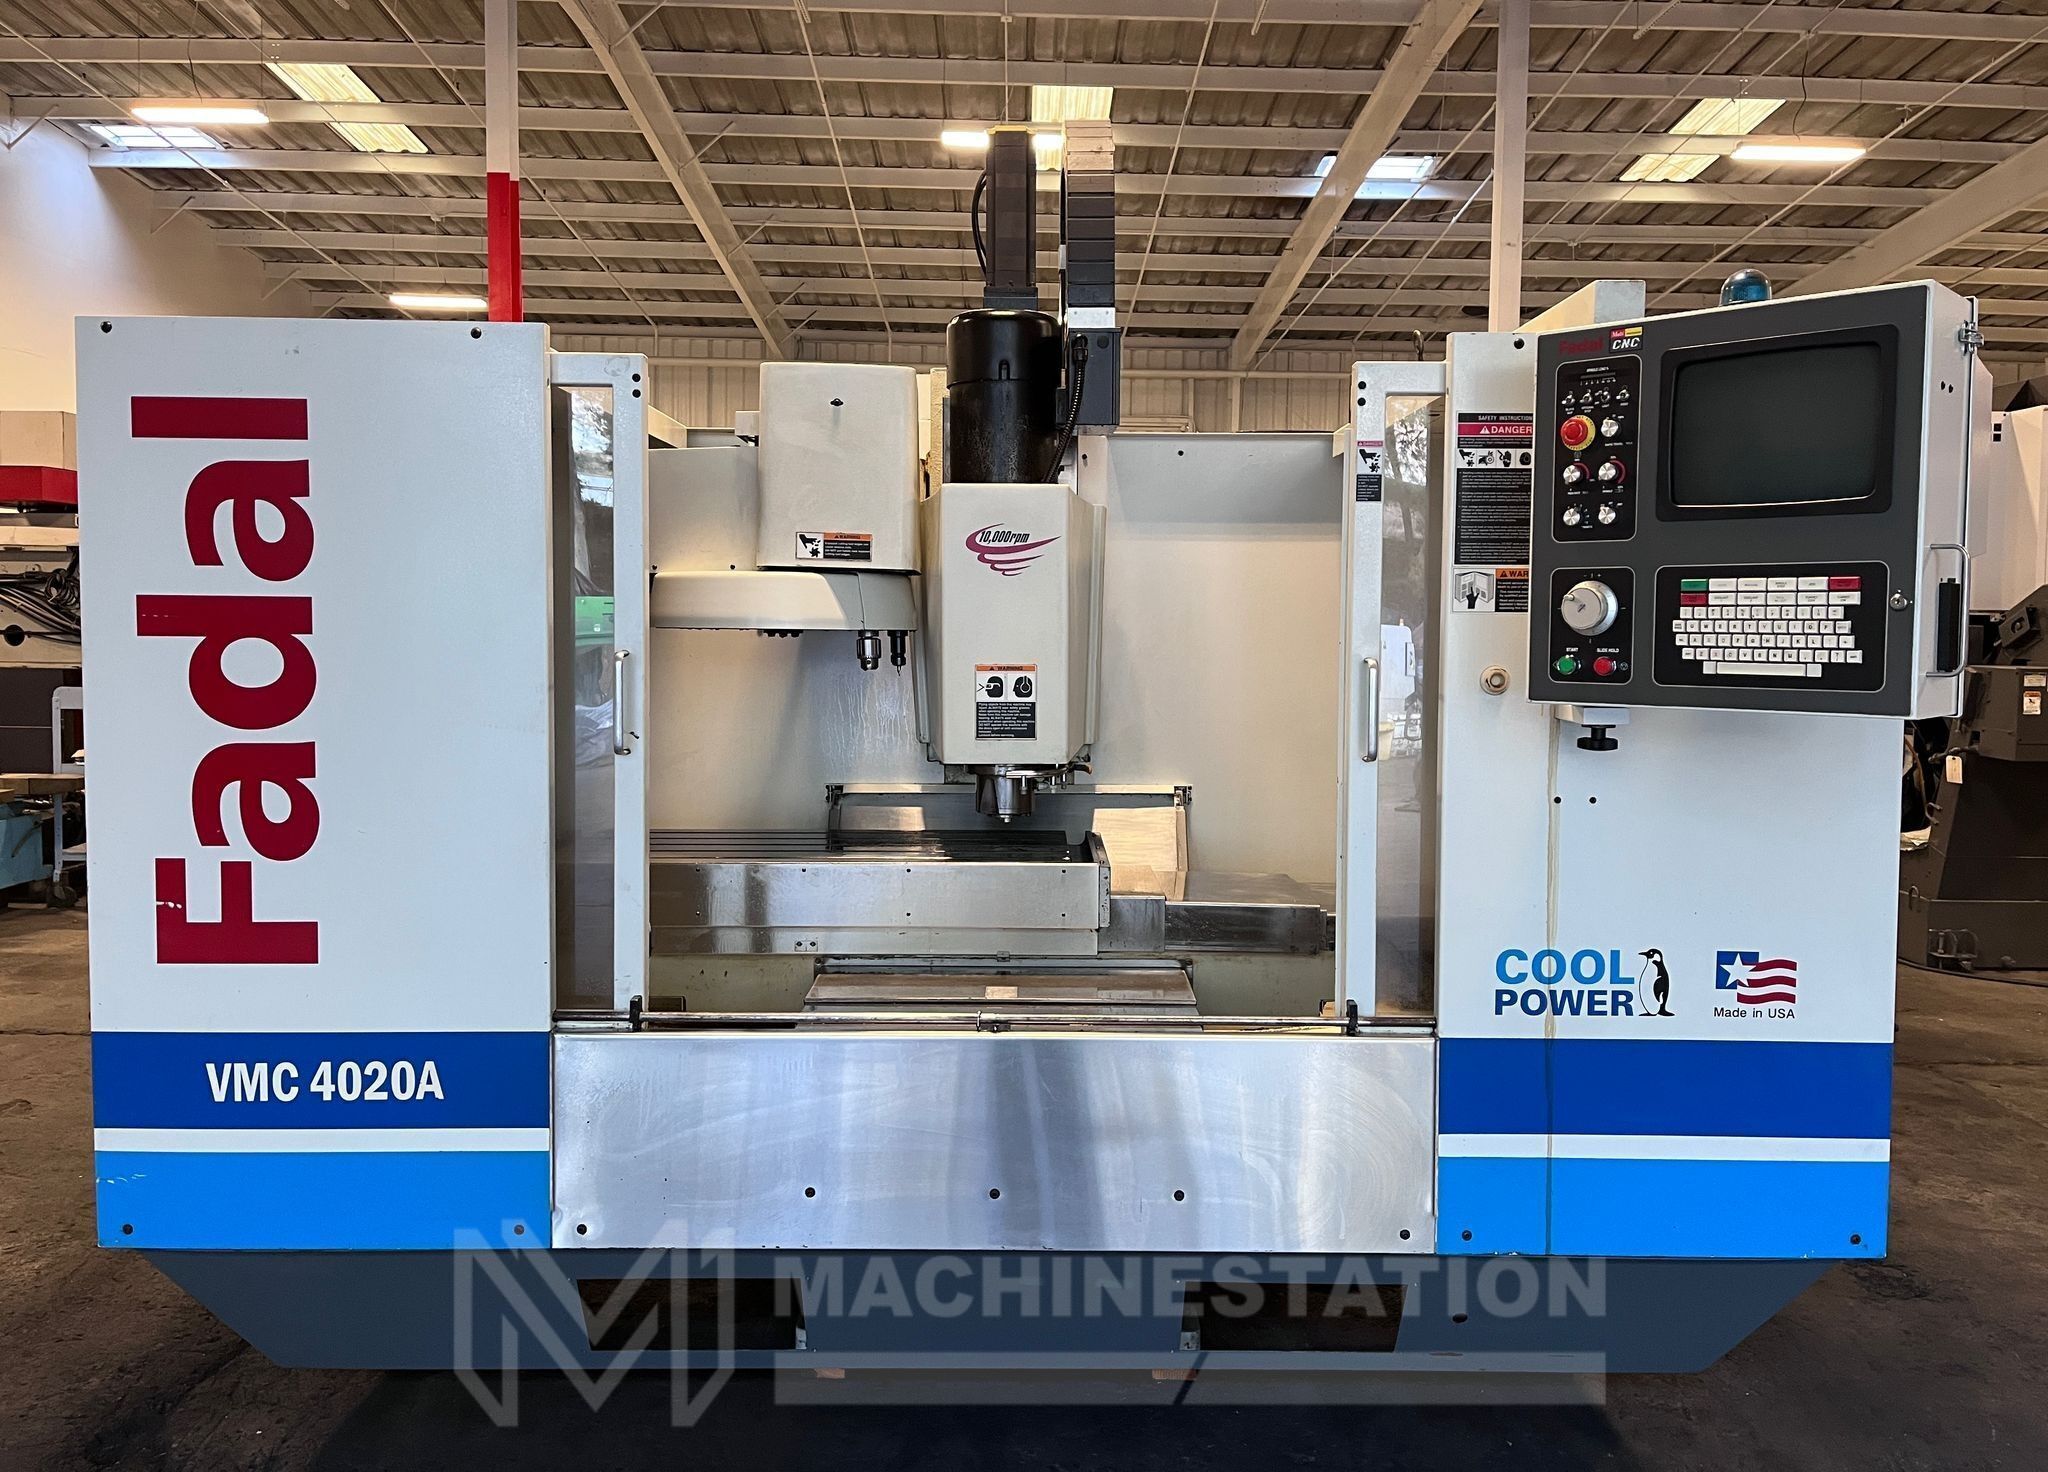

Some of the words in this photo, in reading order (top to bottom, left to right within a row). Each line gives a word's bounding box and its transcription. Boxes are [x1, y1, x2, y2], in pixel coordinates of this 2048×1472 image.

[1612, 337, 1640, 350] CNC
[1491, 425, 1533, 434] DANGER
[978, 530, 1030, 544] 10,000rpm
[131, 396, 320, 964] Fadal
[1495, 948, 1635, 985] COOL
[1494, 989, 1635, 1017] POWER
[1713, 1007, 1747, 1018] Made
[1752, 1007, 1763, 1018] in
[1768, 1008, 1796, 1019] USA
[205, 1061, 300, 1103] VMC
[310, 1060, 445, 1103] 4020A
